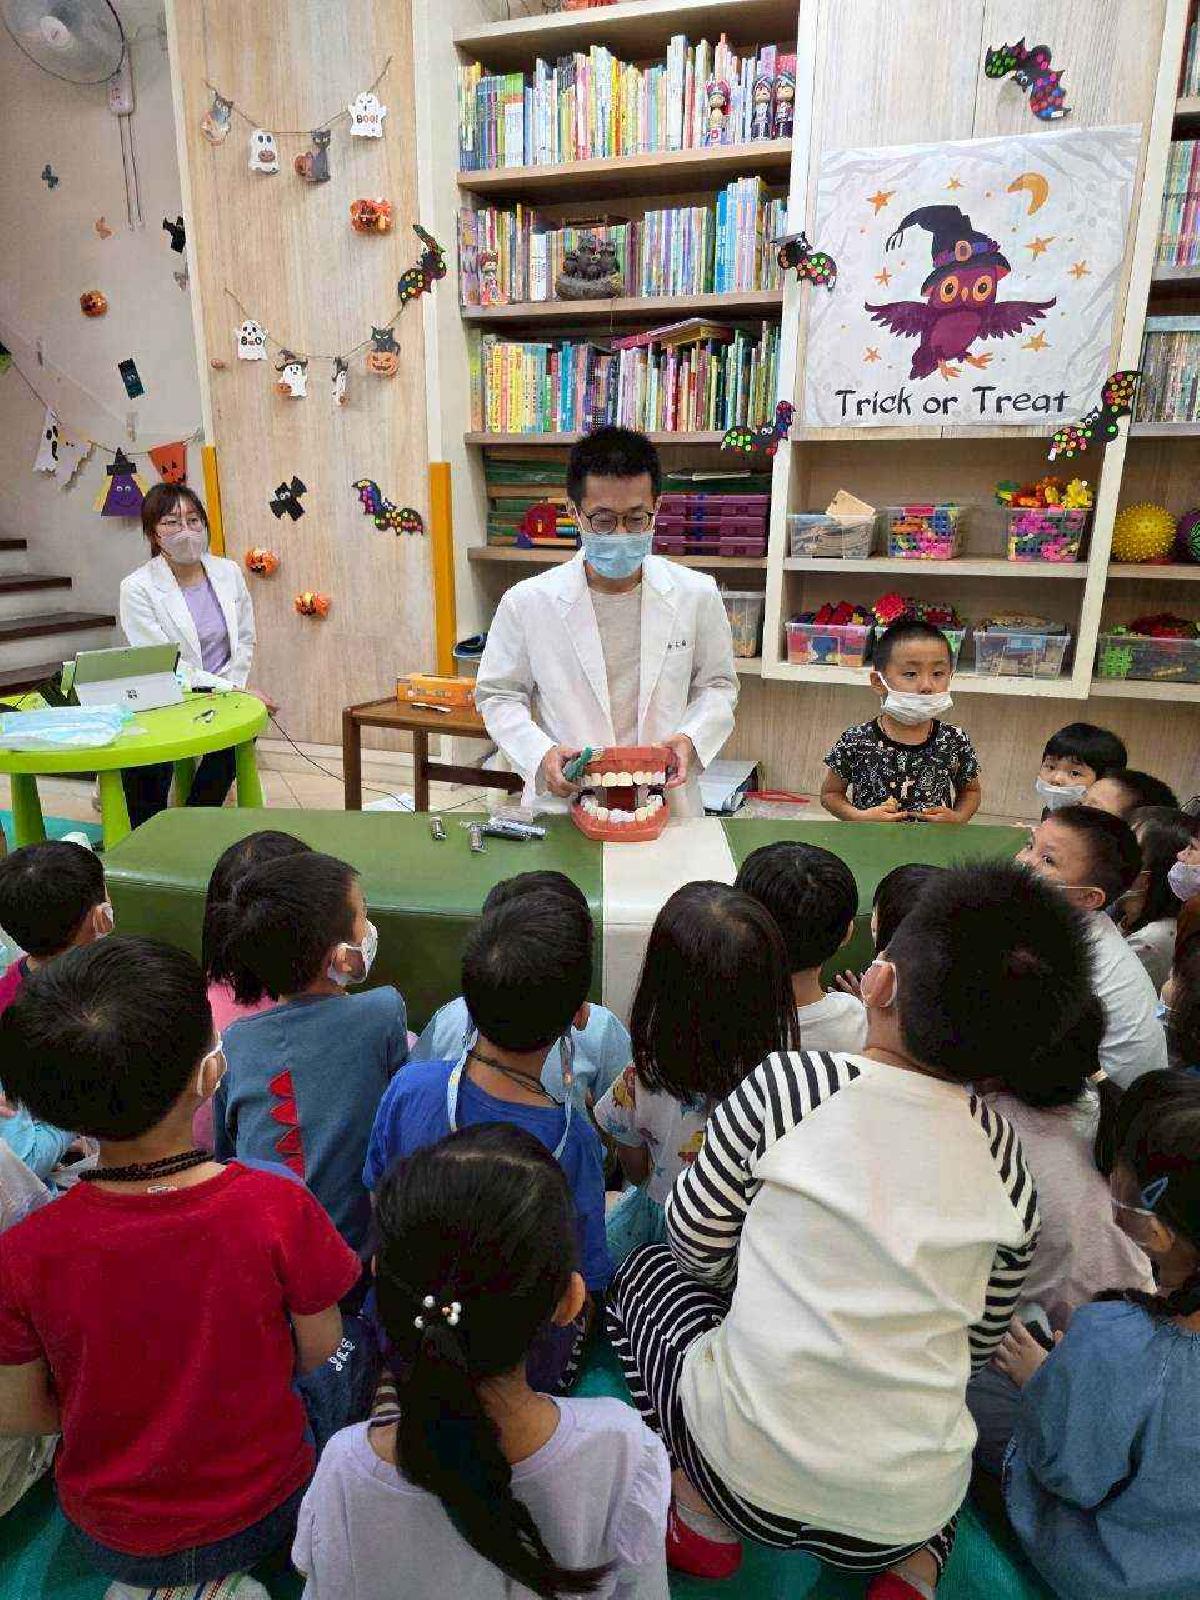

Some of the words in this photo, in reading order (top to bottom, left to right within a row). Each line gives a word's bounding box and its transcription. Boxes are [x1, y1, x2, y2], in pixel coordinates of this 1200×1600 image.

[356, 114, 379, 124] BOO!
[834, 386, 914, 416] Trick
[922, 396, 959, 415] or
[971, 385, 1071, 414] Treat
